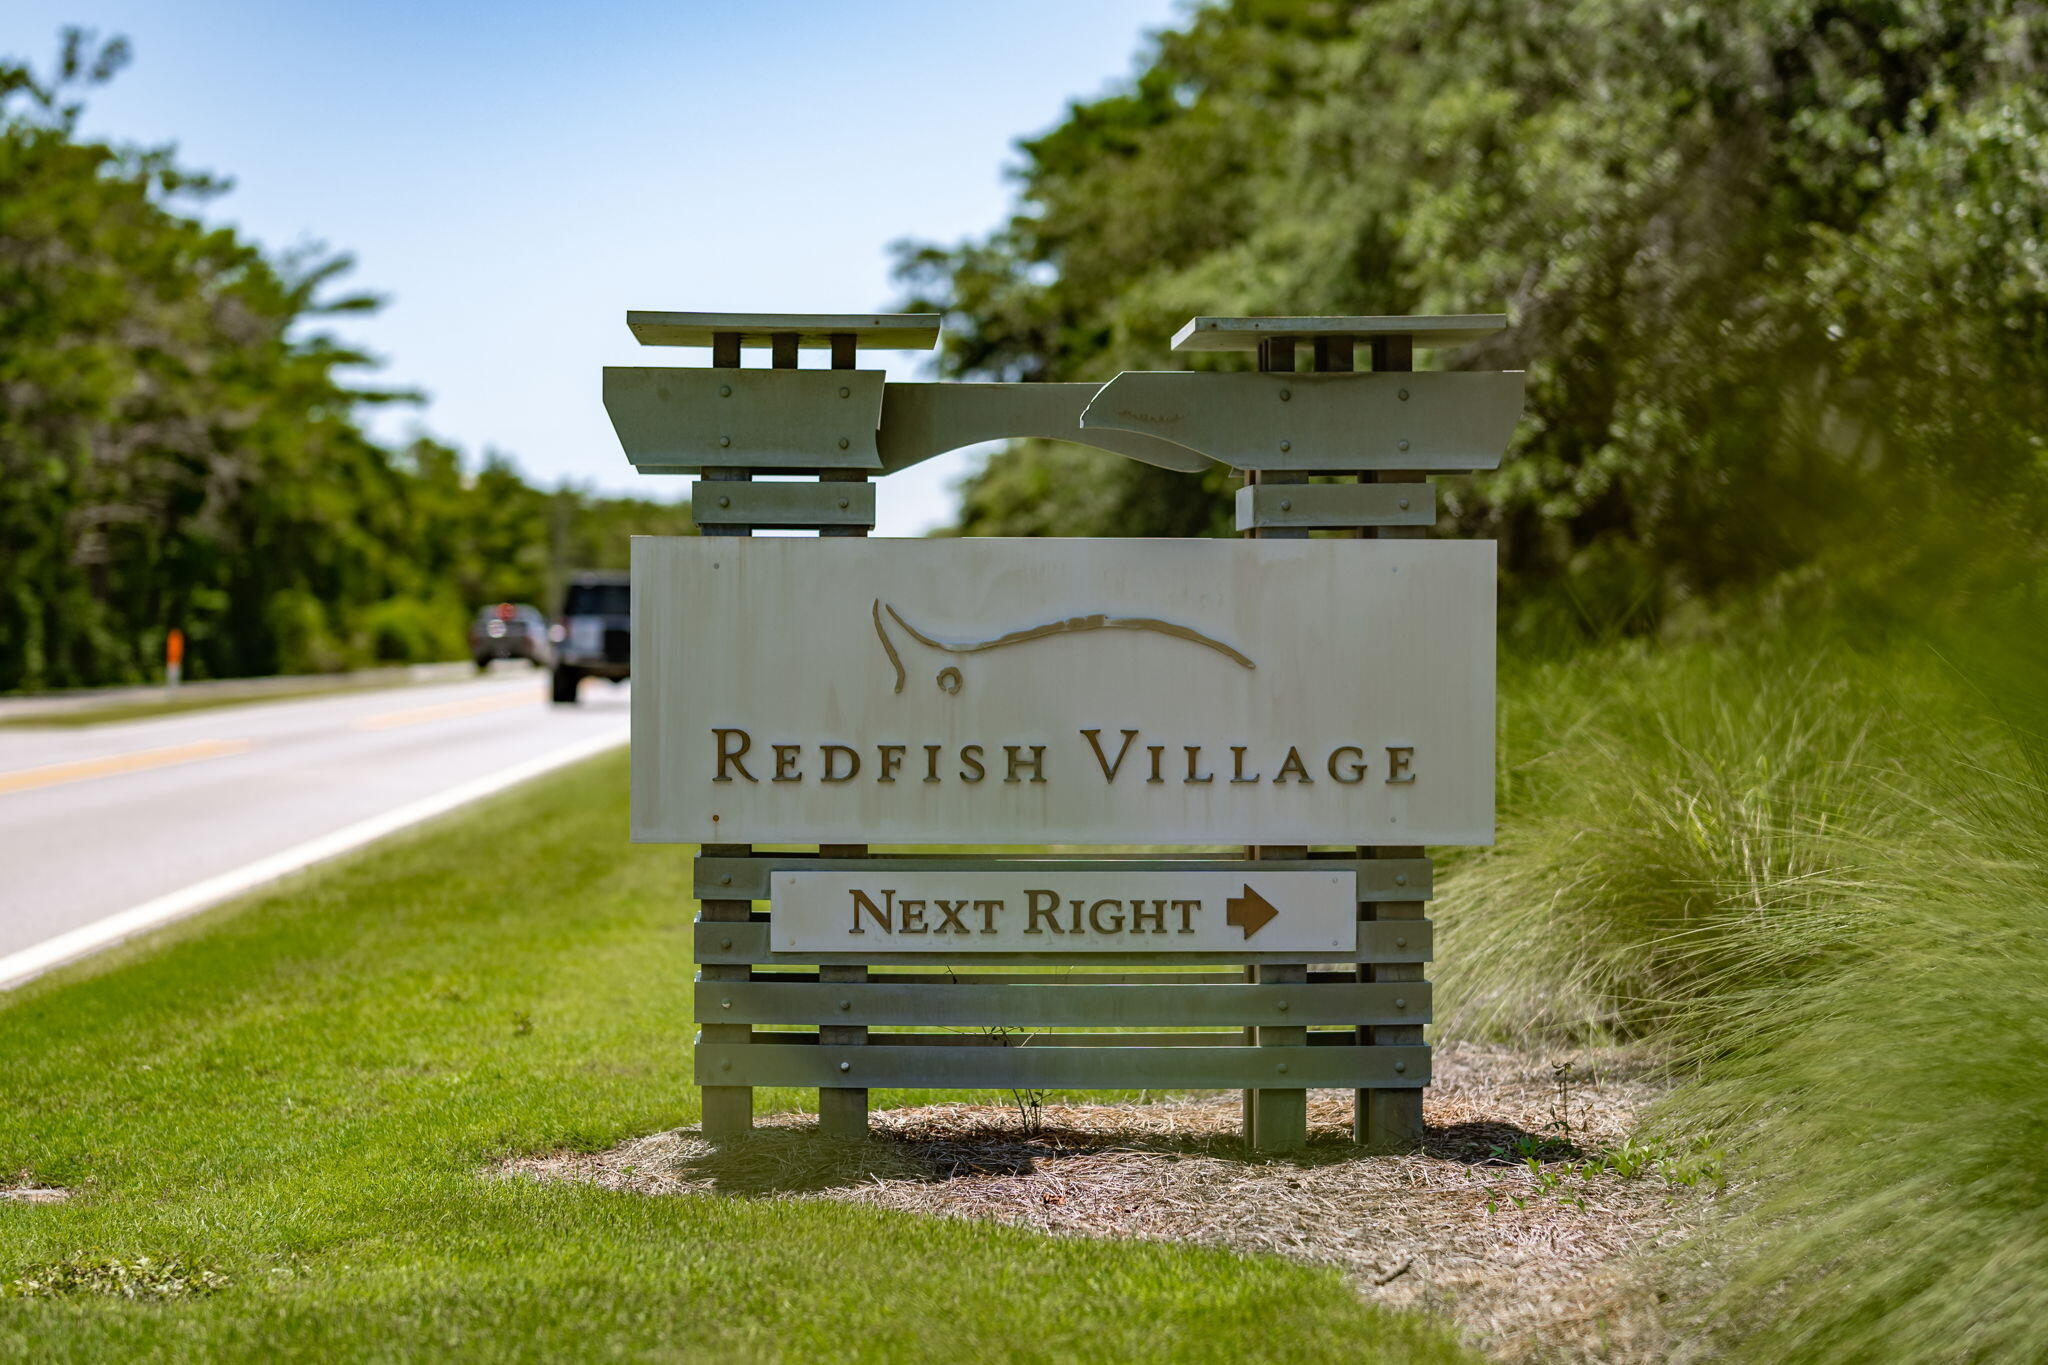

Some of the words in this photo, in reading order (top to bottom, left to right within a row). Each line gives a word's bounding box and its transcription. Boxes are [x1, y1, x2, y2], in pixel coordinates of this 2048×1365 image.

[711, 727, 1047, 783] REDFISH
[1079, 728, 1417, 784] VILLAGE
[848, 888, 1005, 934] NEXT
[1022, 888, 1202, 934] RIGHT
